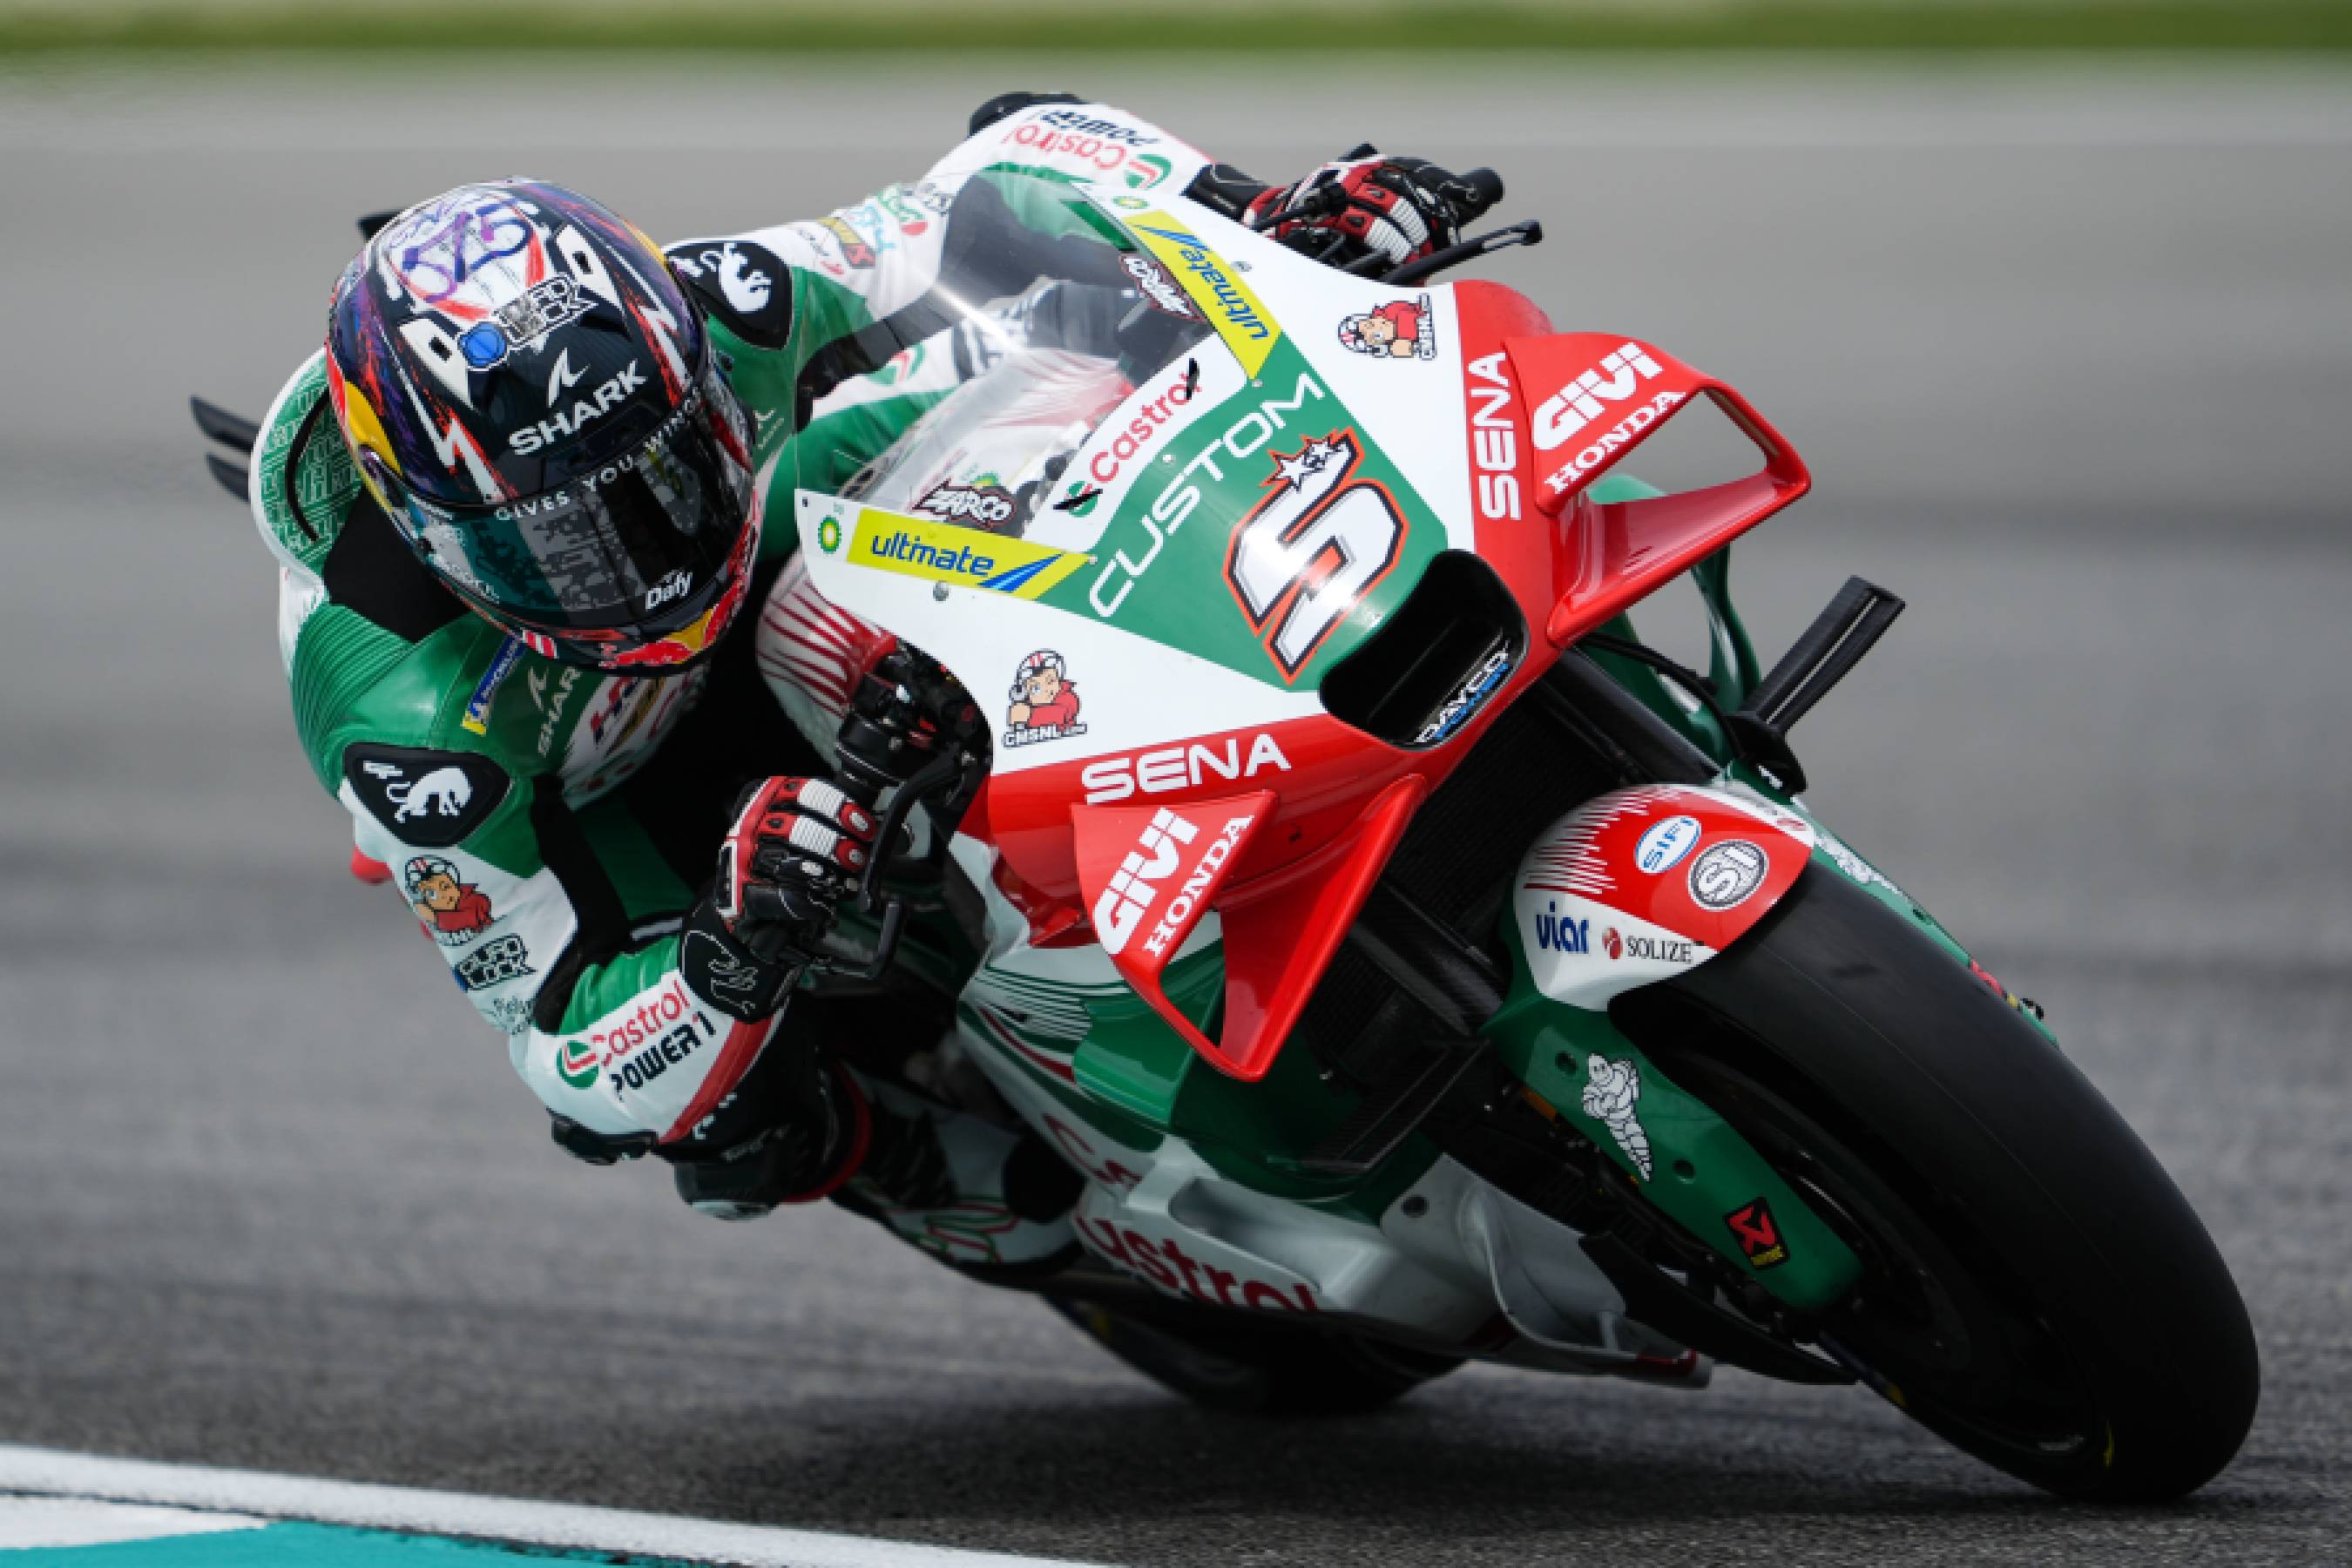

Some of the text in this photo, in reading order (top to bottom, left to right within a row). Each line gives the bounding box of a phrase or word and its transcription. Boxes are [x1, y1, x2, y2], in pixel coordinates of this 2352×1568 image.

[1002, 125, 1126, 170] Castrol
[1179, 248, 1269, 339] ultimate
[509, 358, 648, 455] SHARK
[1469, 352, 1522, 521] SENA
[1532, 341, 1662, 450] GIVI
[582, 454, 634, 492] YOU
[1547, 390, 1686, 495] HONDA
[916, 484, 1016, 525] ZARCO
[1088, 371, 1328, 618] CUSTOM
[645, 571, 693, 611] Dafy
[871, 531, 995, 577] ultimate
[1225, 428, 1408, 686] 5
[1413, 652, 1509, 743] DAYCO
[1081, 733, 1291, 805] SENA
[1092, 808, 1200, 955] GIVI
[1147, 815, 1254, 958] HONDA
[1643, 817, 1695, 868] SIFI
[1536, 901, 1590, 954] viar
[1625, 935, 1692, 963] SOLIZE
